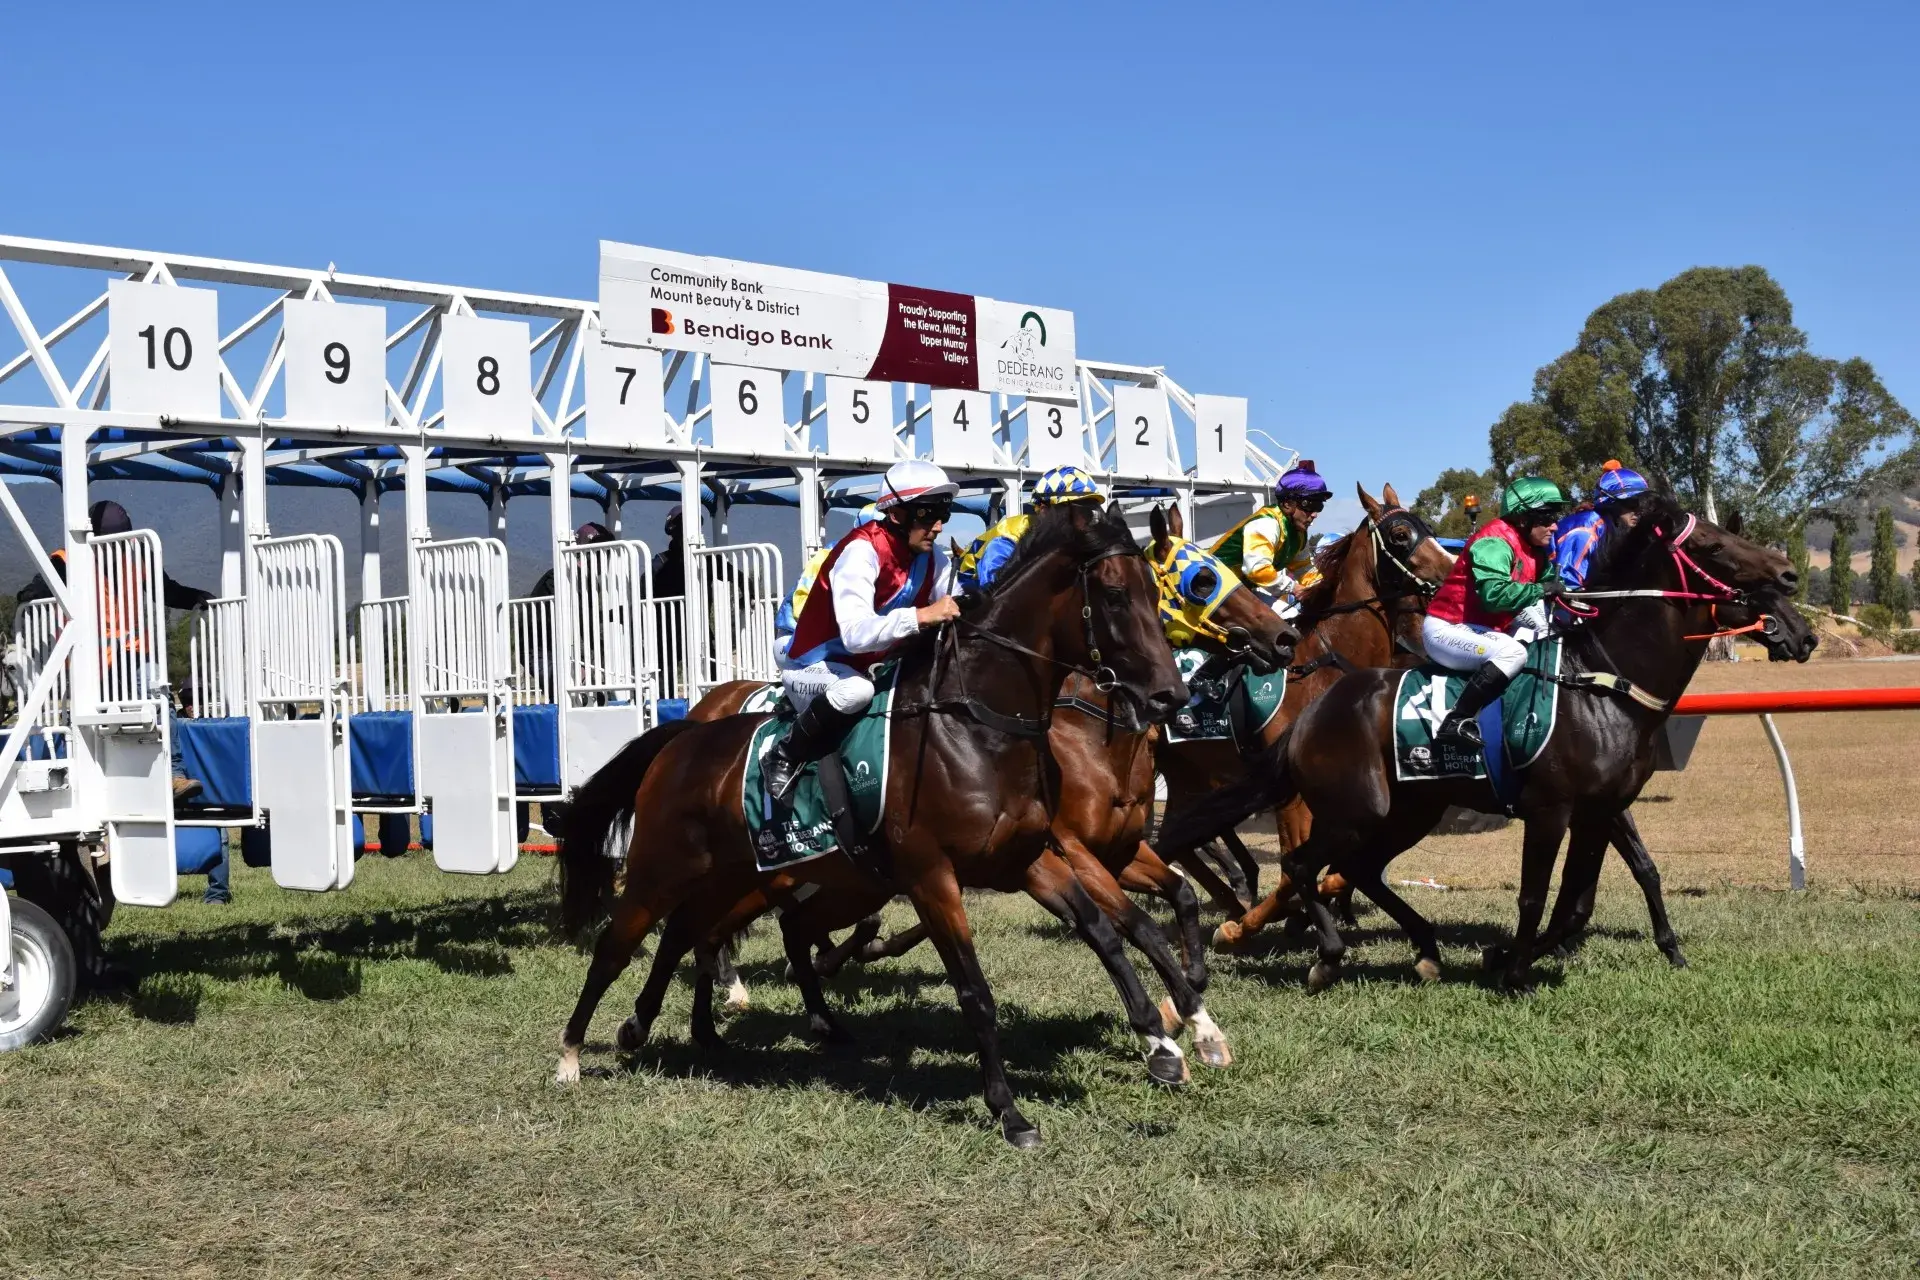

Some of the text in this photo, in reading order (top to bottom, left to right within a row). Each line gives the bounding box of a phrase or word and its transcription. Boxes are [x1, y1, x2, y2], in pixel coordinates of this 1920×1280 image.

[650, 267, 764, 295] Community Bank
[650, 286, 800, 316] Mount Beauty & District
[898, 303, 967, 324] Proudly Supporting
[684, 318, 833, 350] Bendigo Bank
[903, 317, 967, 337] the Kiewa, Mitta &
[138, 324, 193, 371] 10
[920, 334, 968, 352] Upper Murray
[324, 341, 351, 385] 9
[942, 351, 969, 366] Valleys
[997, 359, 1064, 381] DEDERANG
[476, 355, 501, 396] 8
[615, 367, 637, 405] 7
[1045, 382, 1063, 391] CLUB
[738, 379, 758, 415] 6
[852, 389, 870, 424] 5
[953, 399, 969, 432] 4
[1047, 407, 1063, 438] 3
[1135, 415, 1149, 446] 2
[1214, 423, 1223, 452] 1
[781, 820, 800, 831] THE
[789, 840, 821, 853] HOTEL
